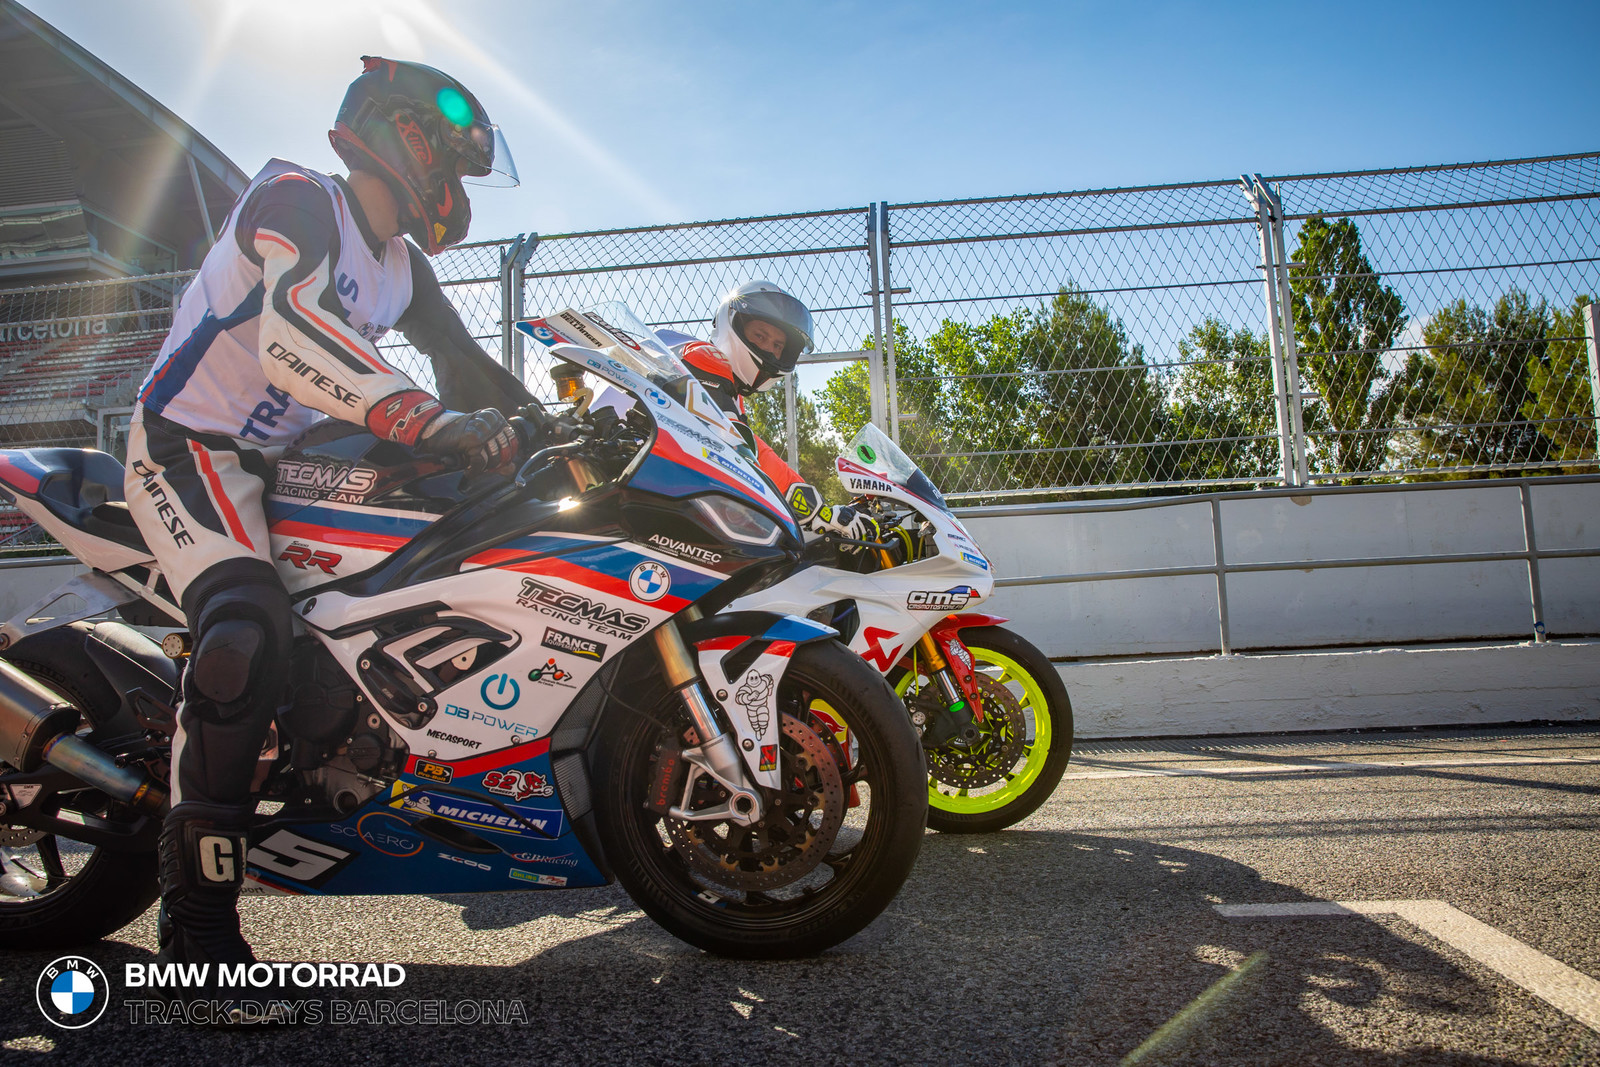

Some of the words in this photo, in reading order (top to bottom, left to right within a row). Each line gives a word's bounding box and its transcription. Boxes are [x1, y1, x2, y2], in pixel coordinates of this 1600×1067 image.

[0, 311, 108, 342] rcelona
[266, 341, 363, 409] DAINESE
[601, 367, 638, 389] POWER
[240, 383, 290, 441] TRA
[721, 460, 761, 488] MICHELIN
[850, 477, 893, 493] YAMAHA
[132, 459, 196, 549] DAINESE
[275, 485, 319, 499] RACING
[323, 491, 365, 504] TEAM
[278, 545, 343, 576] RR
[648, 533, 722, 564] ADVANTEC
[516, 576, 650, 634] TECMAS
[516, 598, 582, 627] RACING
[587, 622, 633, 641] TEAM
[545, 630, 597, 653] FRANCE
[444, 704, 470, 720] DB
[471, 712, 539, 738] POWER
[426, 728, 483, 750] MECASPORT
[483, 772, 518, 790] S2
[656, 758, 675, 806] brembo
